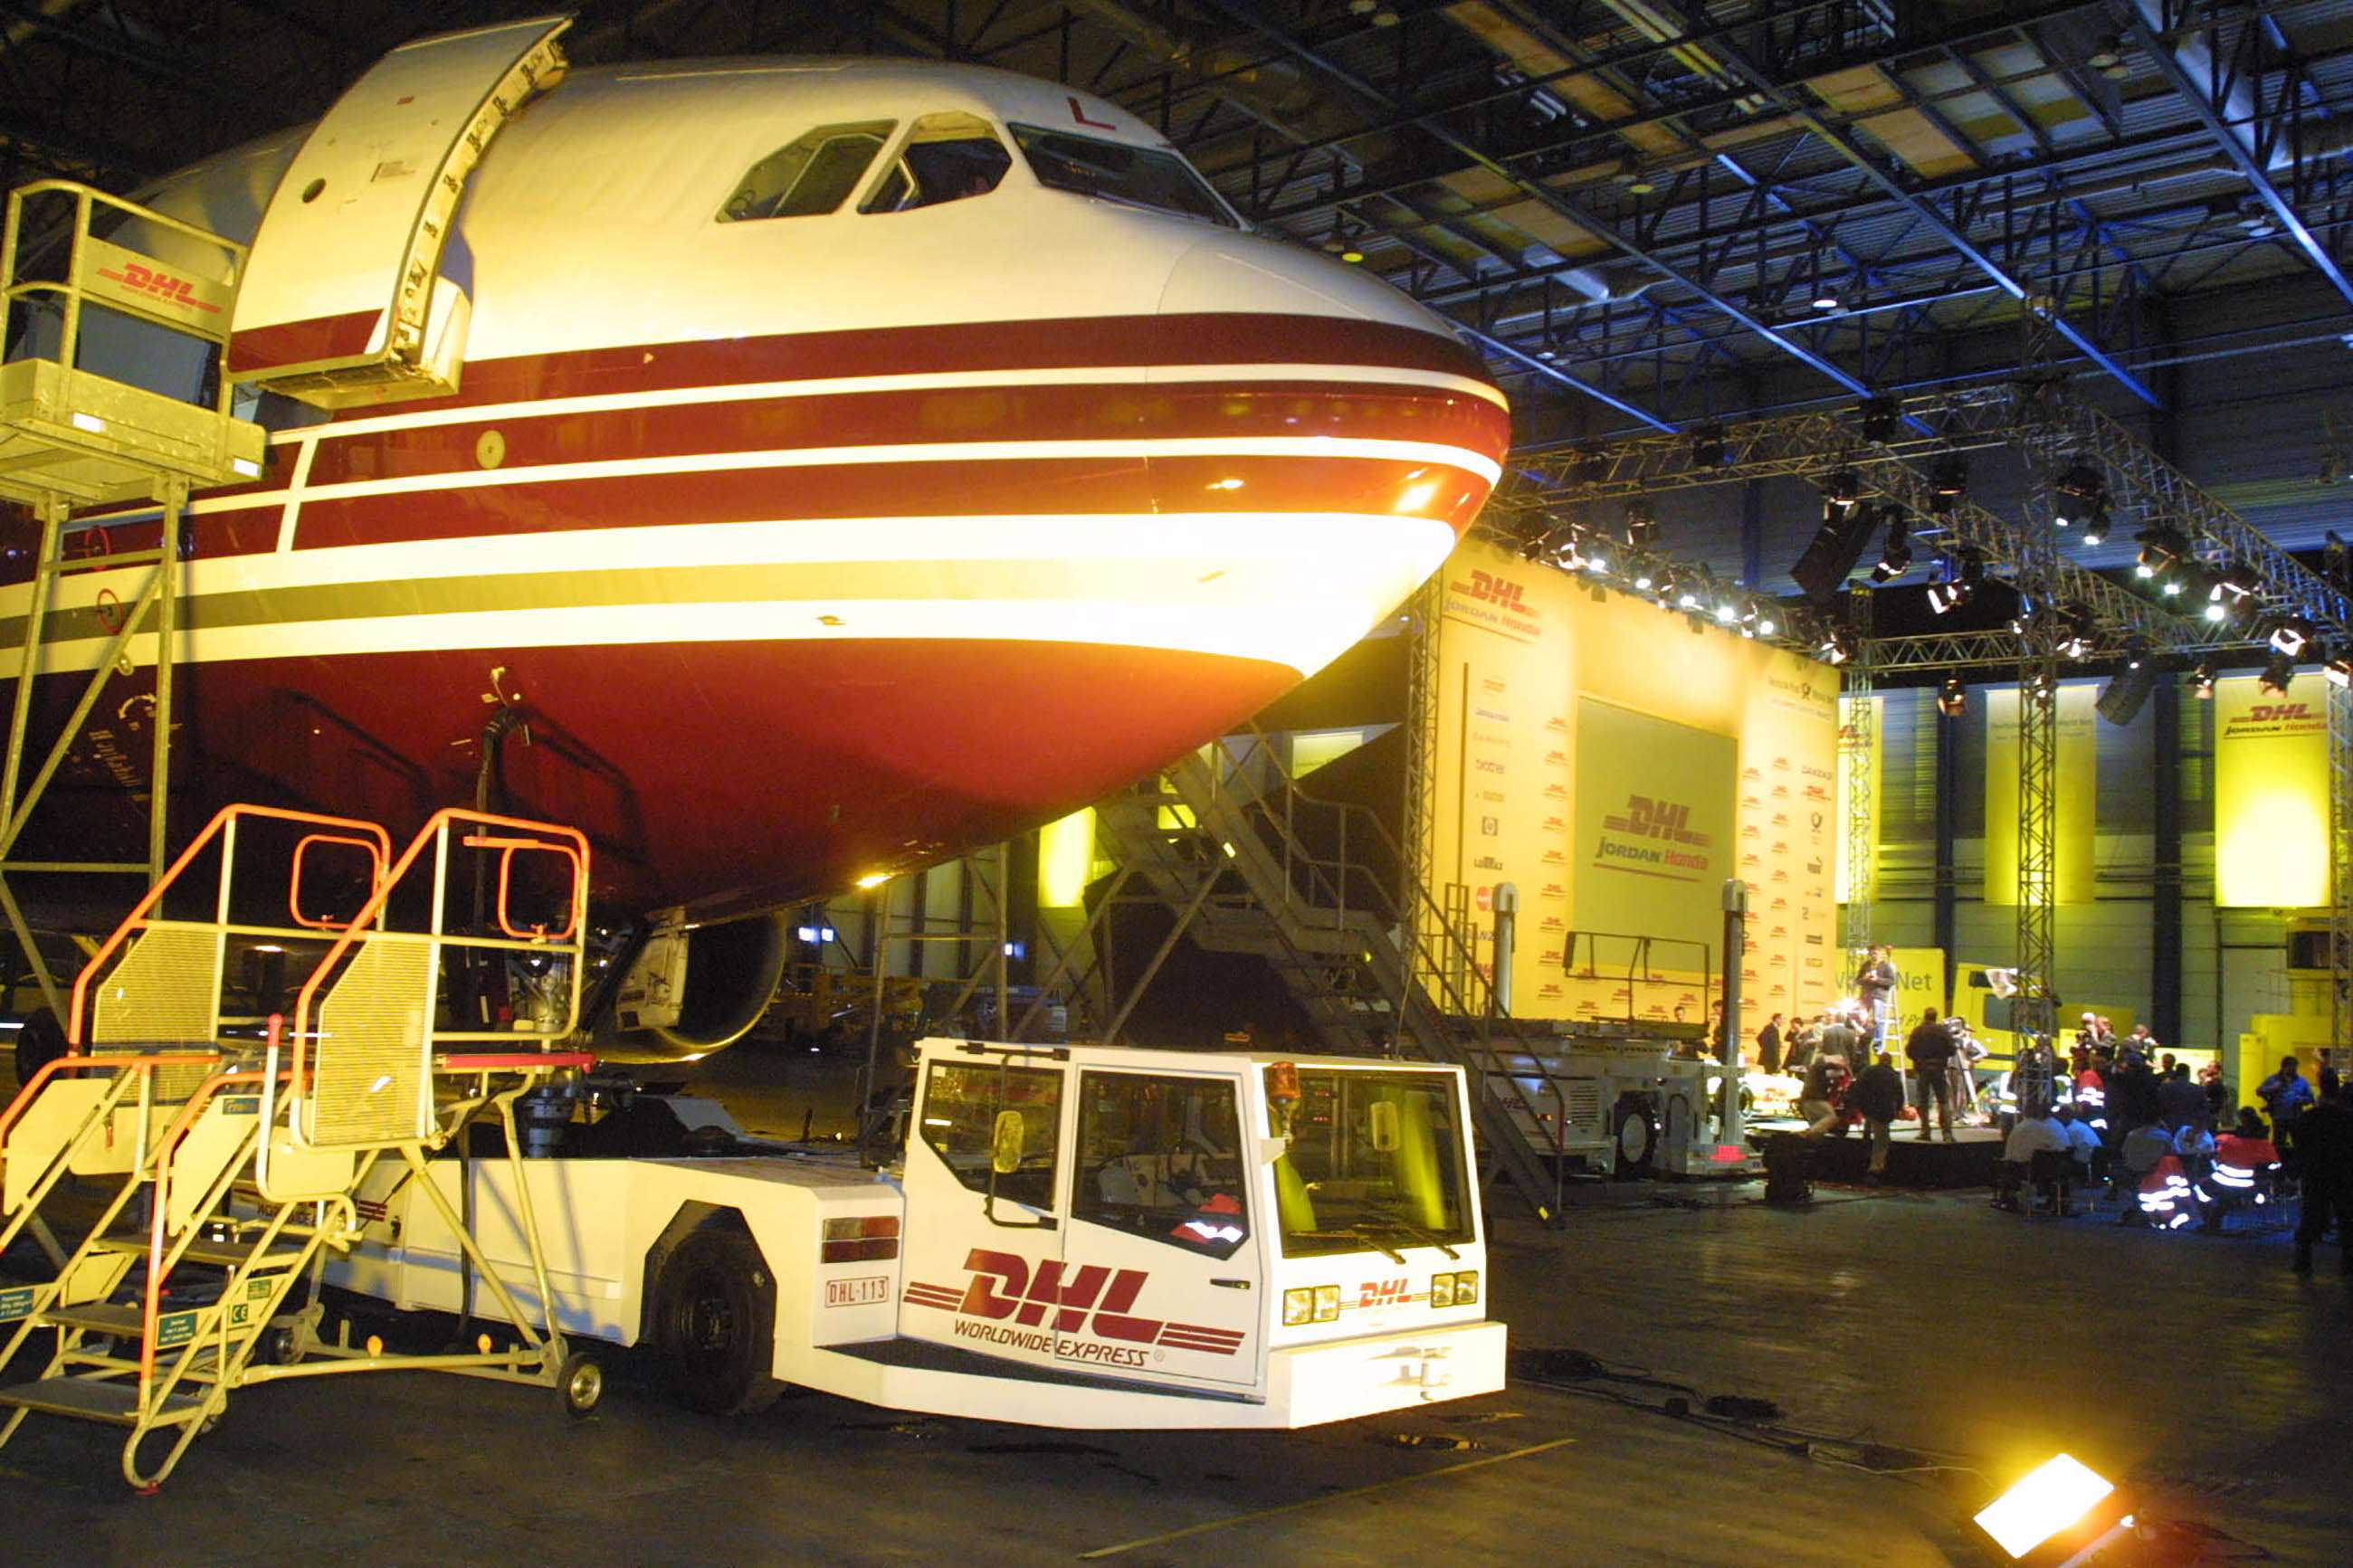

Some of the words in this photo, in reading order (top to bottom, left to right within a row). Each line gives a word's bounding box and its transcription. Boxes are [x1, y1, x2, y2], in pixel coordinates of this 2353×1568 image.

[123, 262, 196, 305] DHL
[1470, 568, 1527, 613] DHL
[2249, 703, 2312, 722] DHL
[1627, 794, 1695, 843] DHL
[1896, 970, 1933, 992] Net
[829, 1279, 886, 1303] DHL-113
[959, 1248, 1164, 1344] DHL
[1358, 1278, 1412, 1308] DHL
[953, 1318, 1053, 1354] WORLDWIDE
[1055, 1339, 1150, 1367] EXPRESS
